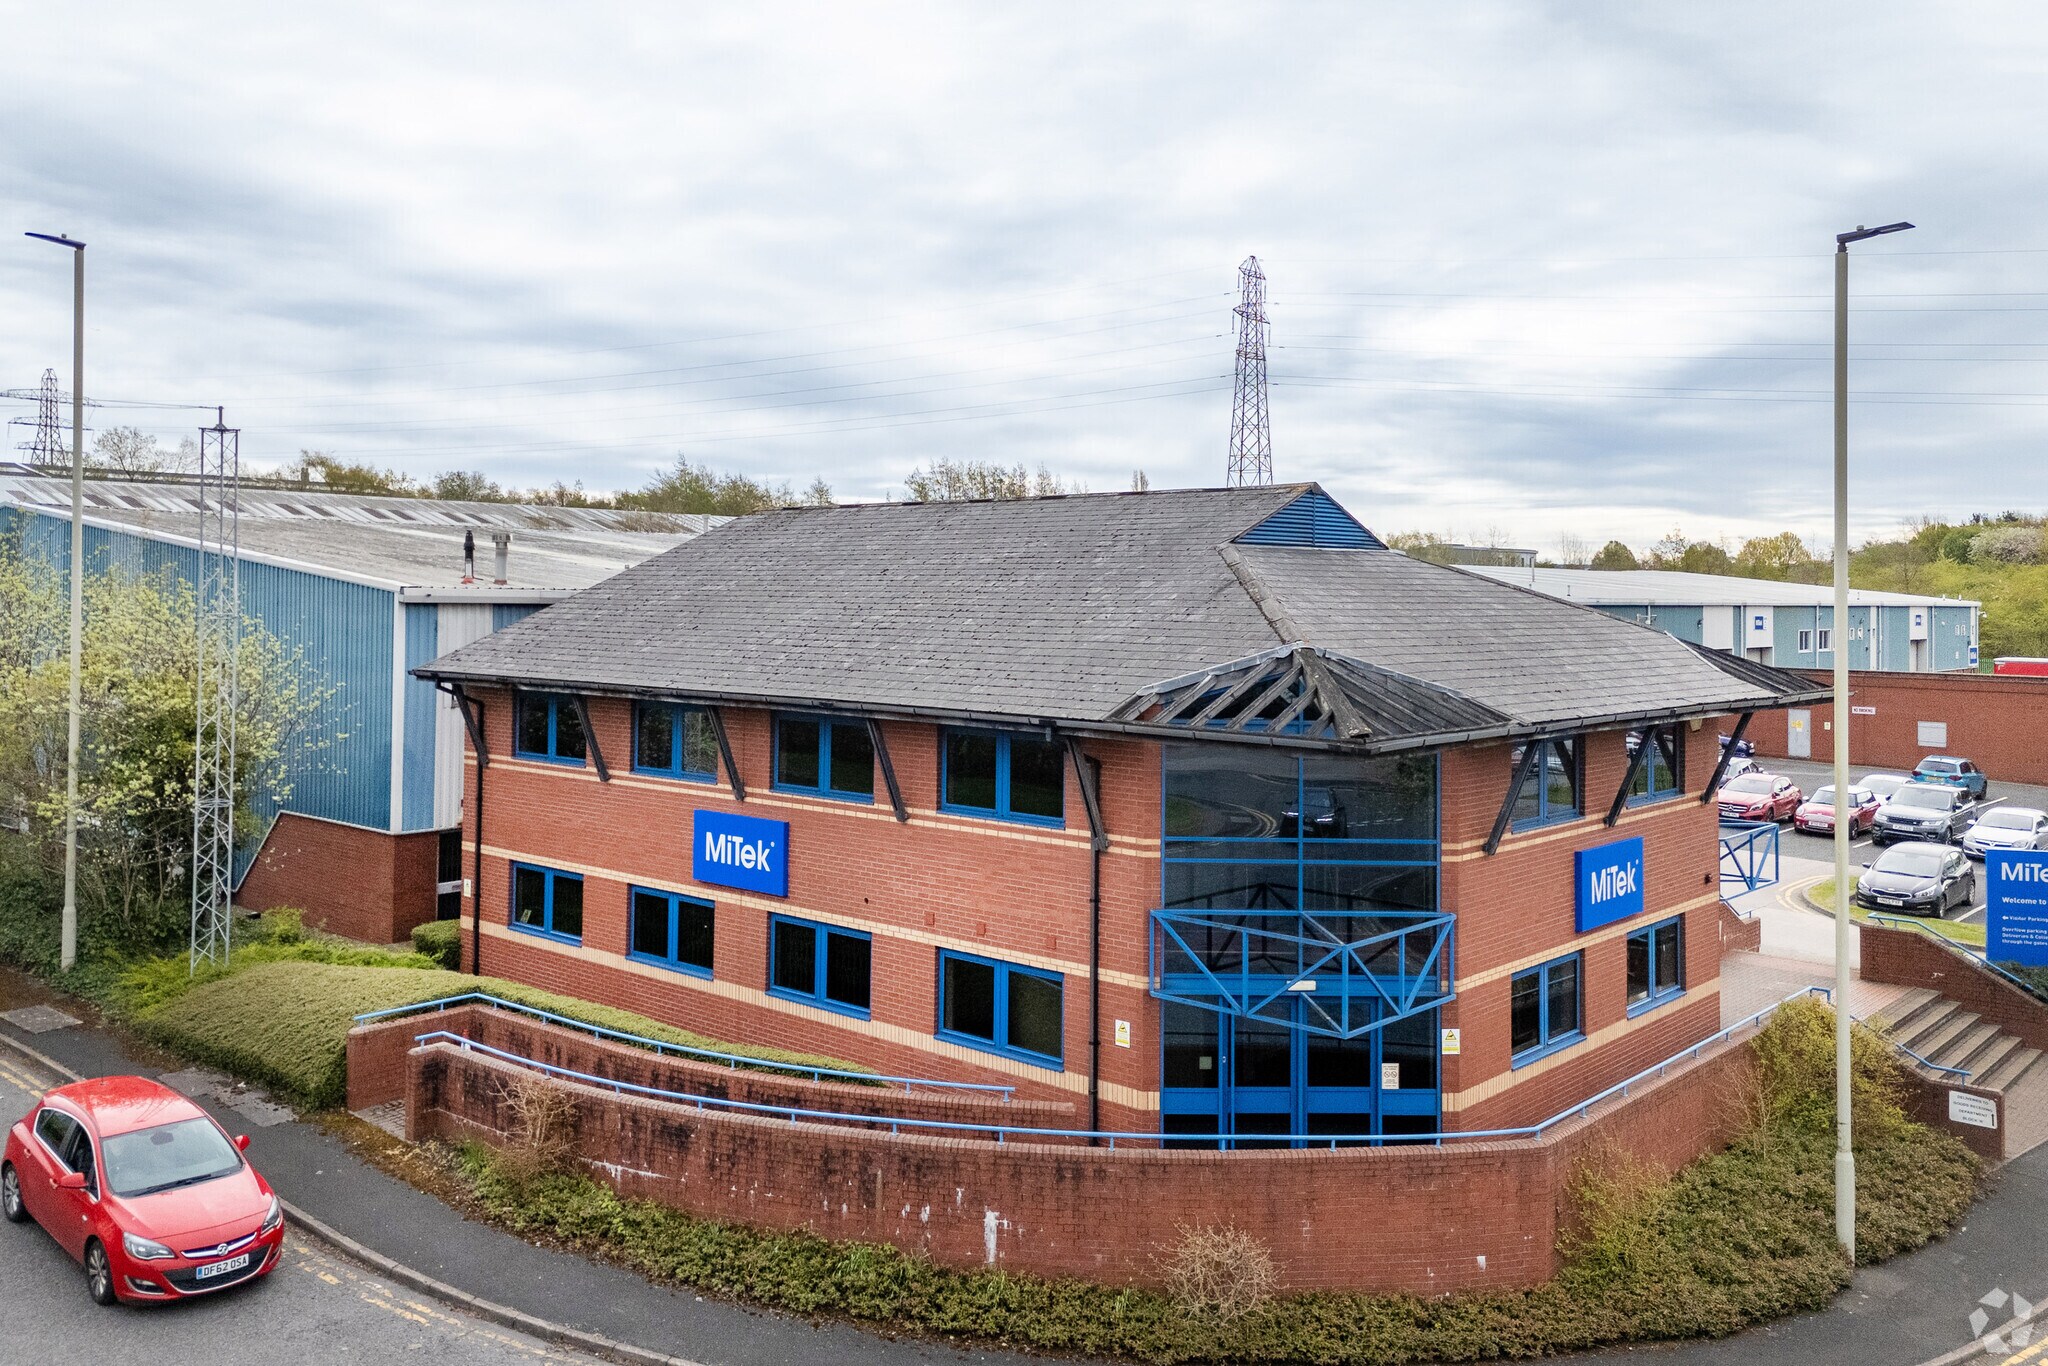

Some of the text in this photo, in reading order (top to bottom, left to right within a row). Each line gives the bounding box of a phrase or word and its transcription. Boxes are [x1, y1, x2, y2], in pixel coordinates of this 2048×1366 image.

[705, 831, 771, 872] MiTek
[1591, 861, 1636, 905] MiTek
[1959, 1109, 1987, 1117] DEPARTMENT
[204, 1256, 246, 1276] DF62 OSA
